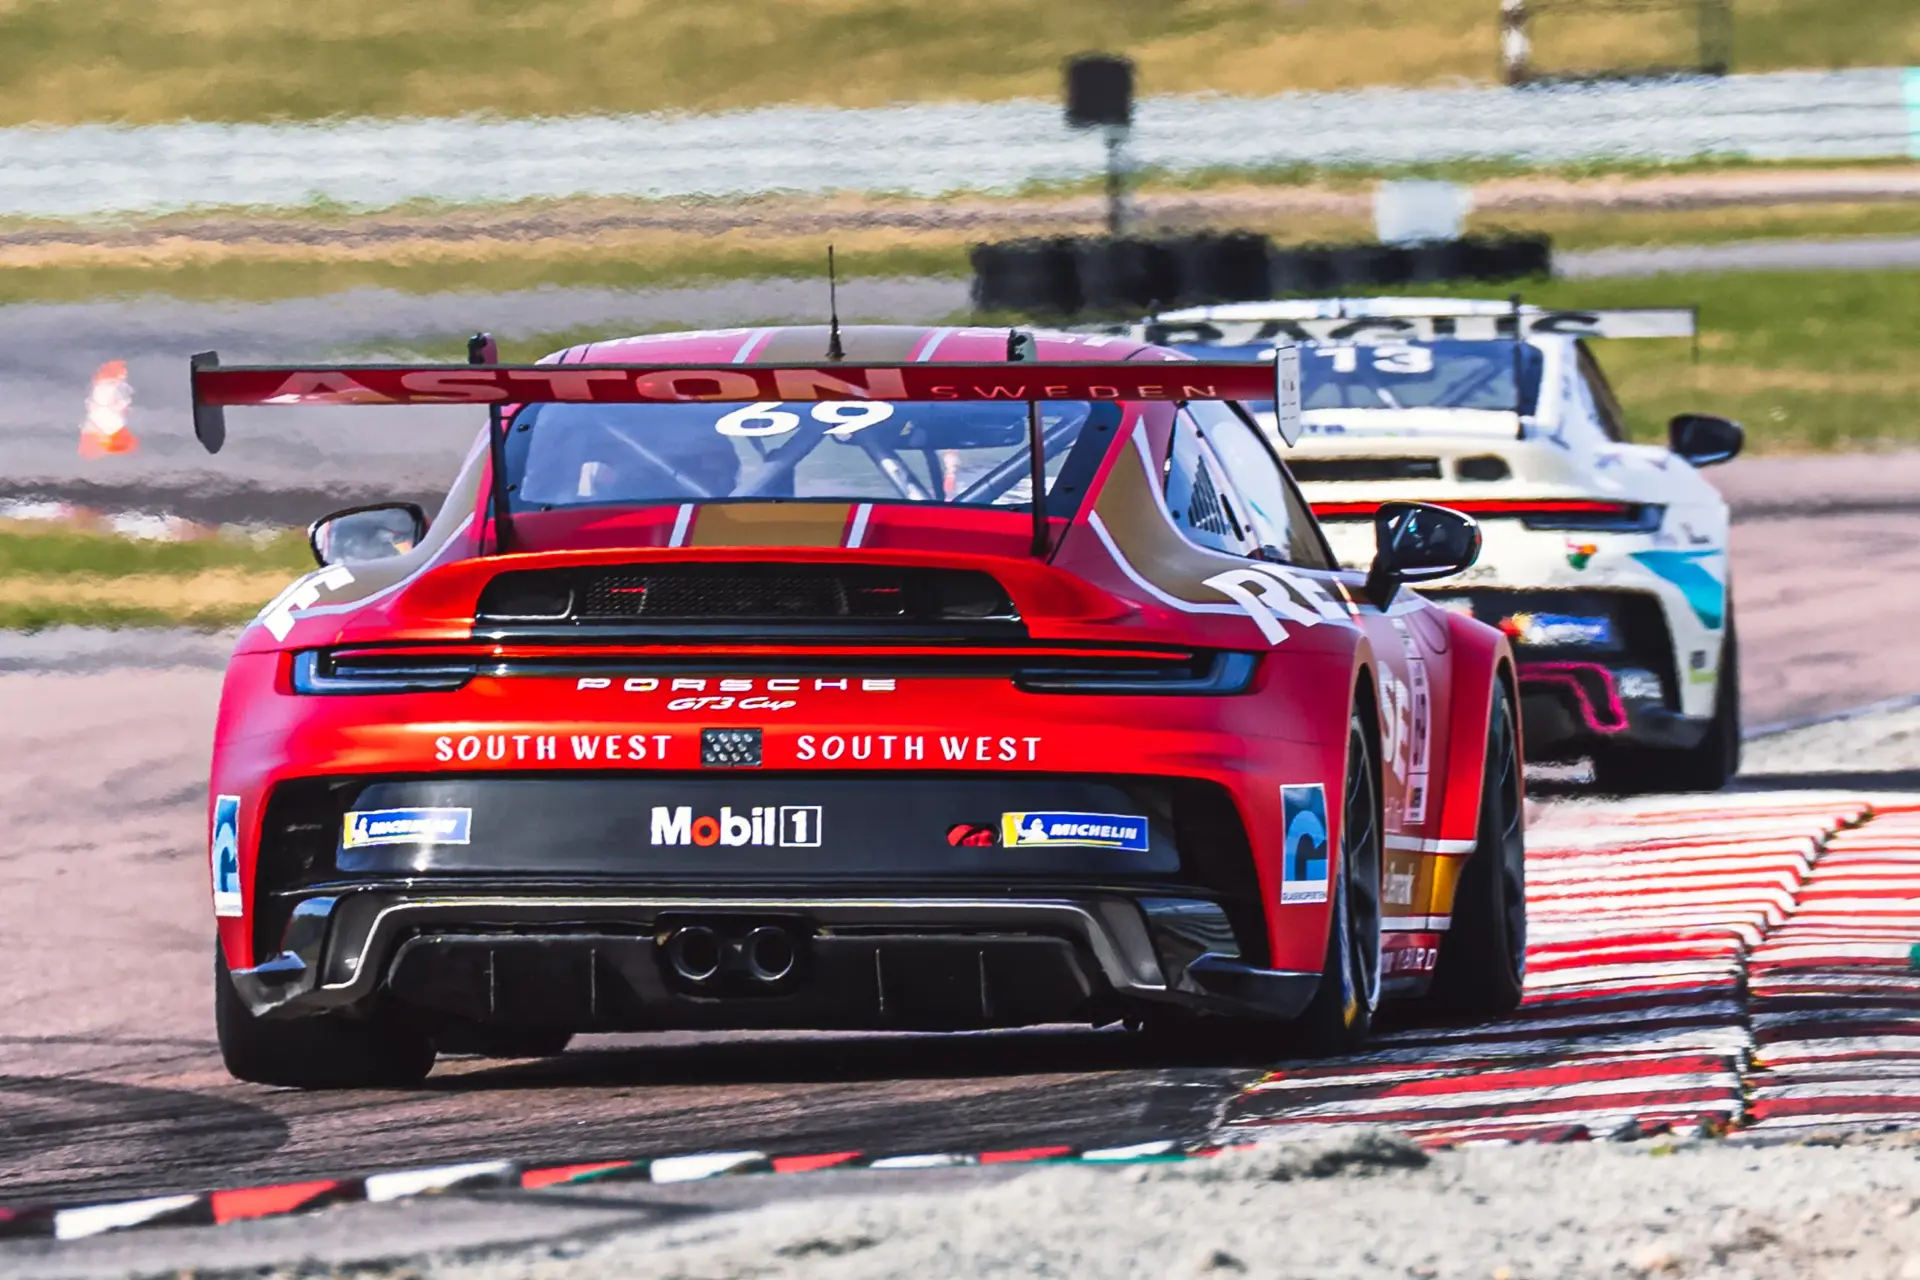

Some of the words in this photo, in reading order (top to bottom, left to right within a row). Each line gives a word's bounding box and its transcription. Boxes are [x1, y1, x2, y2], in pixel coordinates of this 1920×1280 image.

[261, 370, 908, 402] ASTON
[930, 384, 1217, 399] SWEDEN
[715, 401, 895, 436] 69
[577, 677, 896, 692] PORSCHE
[667, 696, 735, 711] GT3
[738, 696, 797, 711] Cup
[434, 735, 556, 761] SOUTH
[571, 735, 672, 761] WEST
[796, 735, 924, 761] SOUTH
[939, 736, 1042, 761] WEST
[651, 806, 776, 847] Mobil
[1049, 823, 1138, 840] MICHELIN
